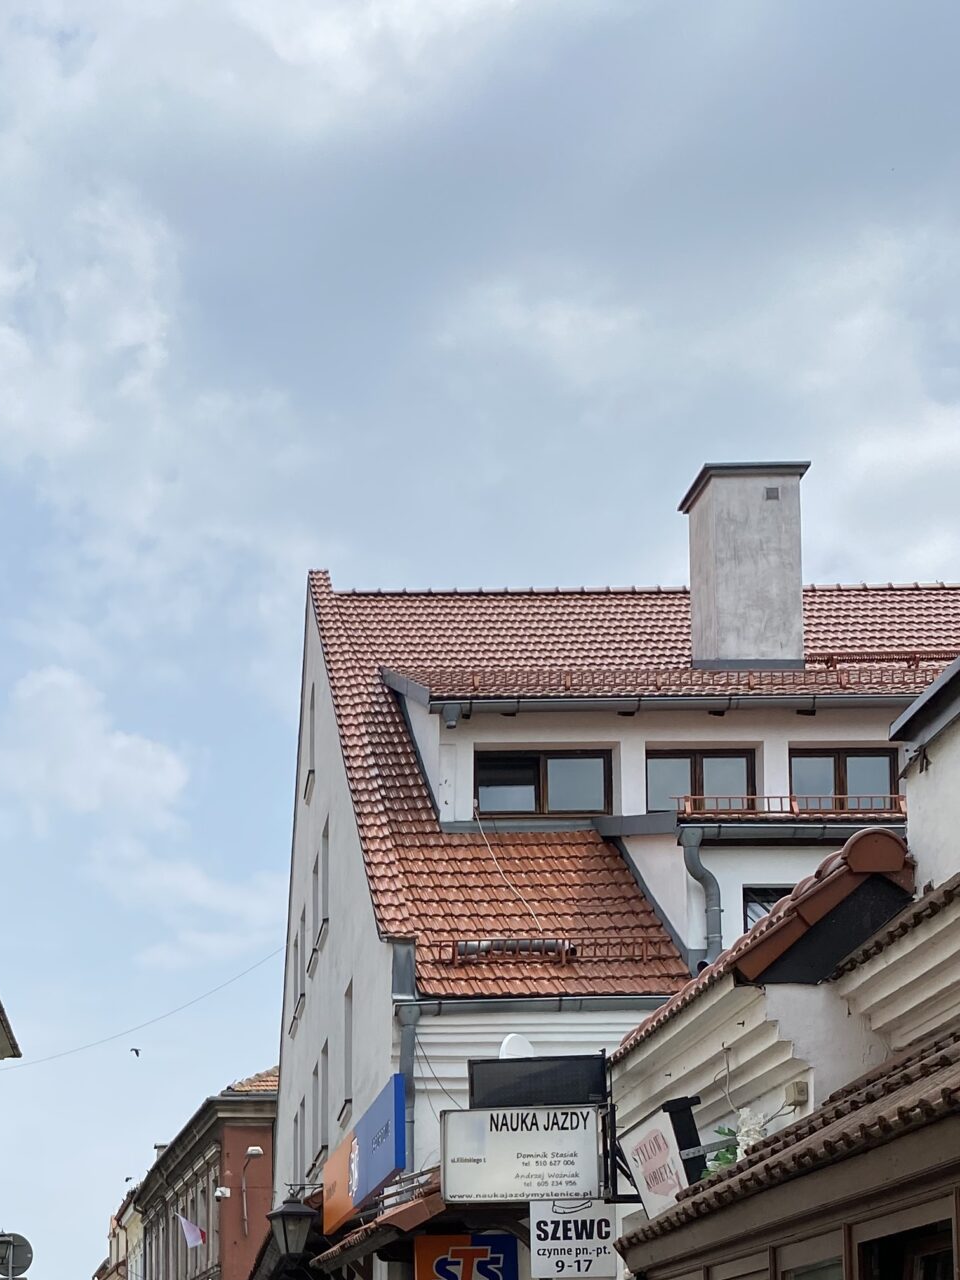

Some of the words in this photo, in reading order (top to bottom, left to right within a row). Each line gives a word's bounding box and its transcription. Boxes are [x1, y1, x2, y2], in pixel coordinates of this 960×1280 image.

[489, 1112, 539, 1132] NAUKA
[543, 1111, 590, 1131] JAZDY
[633, 1133, 669, 1167] STYLOWA
[514, 1172, 545, 1180] Andrzej
[644, 1163, 674, 1191] KOBIETA
[536, 1218, 611, 1241] SZEWC
[537, 1246, 572, 1257] czynne
[575, 1244, 611, 1257] pn.-pt.
[555, 1260, 592, 1273] 9-17
